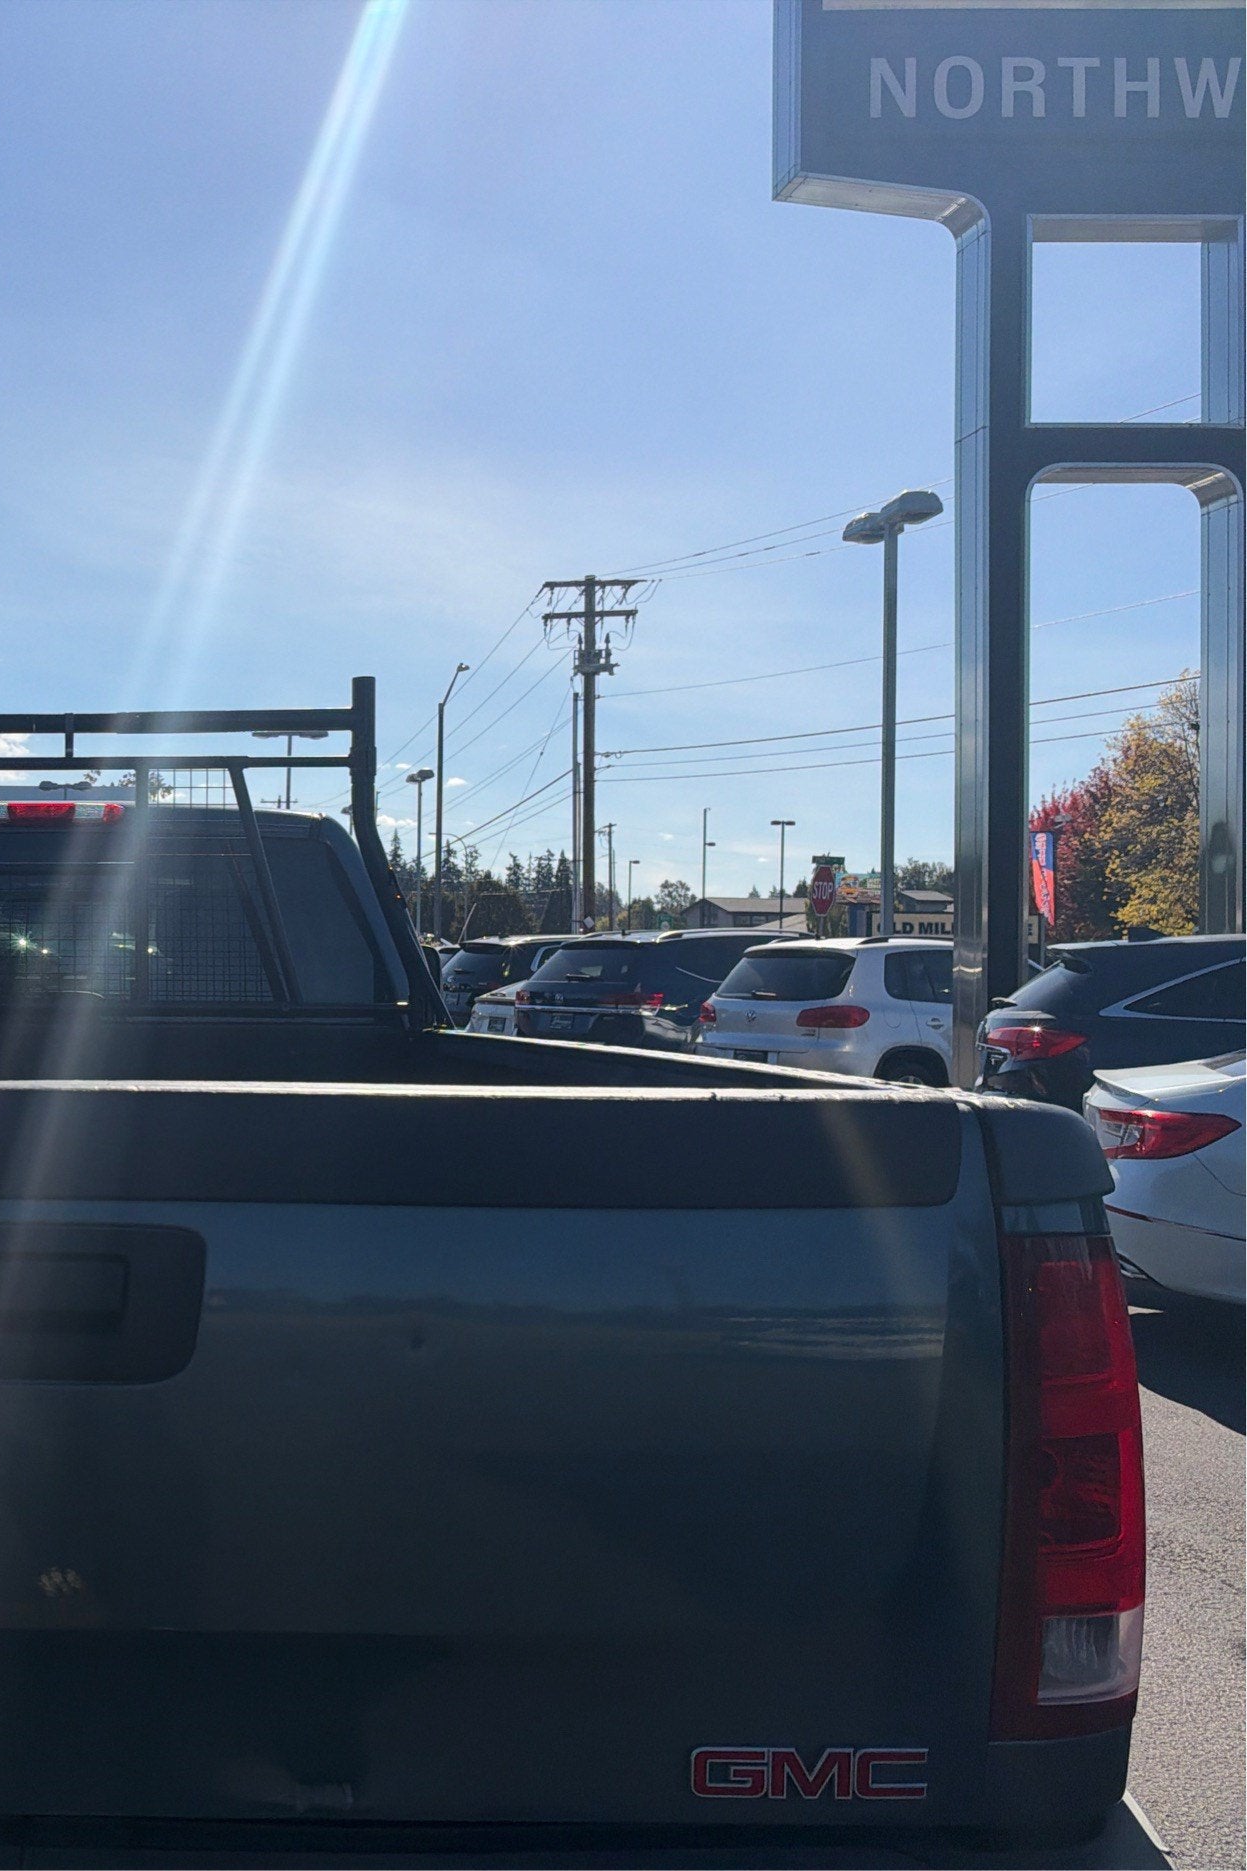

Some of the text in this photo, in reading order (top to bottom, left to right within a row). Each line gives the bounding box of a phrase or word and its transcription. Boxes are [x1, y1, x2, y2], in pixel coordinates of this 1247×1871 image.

[869, 55, 1243, 120] NORTHW
[812, 882, 833, 899] STOP
[877, 922, 954, 934] LD MIL
[691, 1746, 929, 1800] GMC
